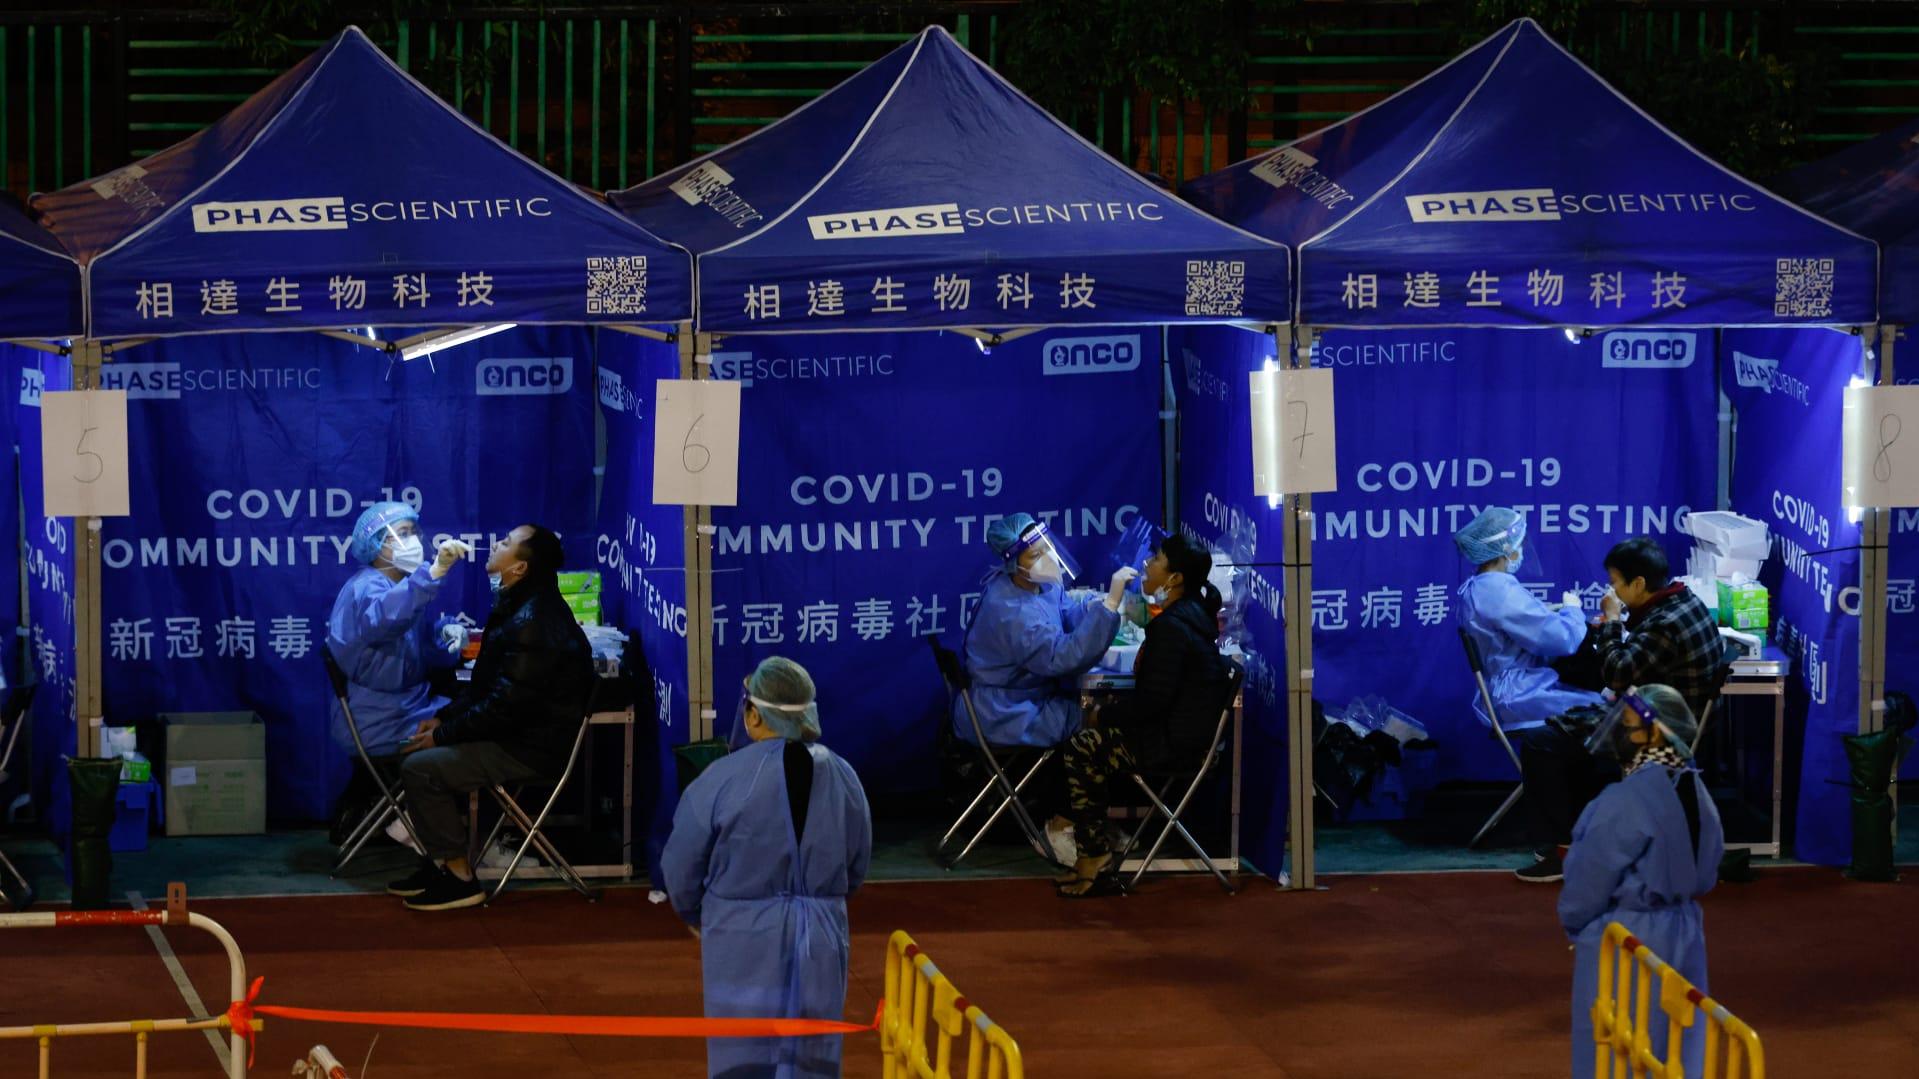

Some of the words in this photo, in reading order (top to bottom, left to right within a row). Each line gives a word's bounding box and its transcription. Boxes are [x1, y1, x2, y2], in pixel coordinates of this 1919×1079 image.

[206, 201, 348, 226] PHASE
[350, 196, 553, 223] SCIENTIFIC
[823, 211, 964, 235] PHASE
[965, 201, 1164, 229] SCIENTIFIC
[1423, 195, 1560, 216] PHASE
[1561, 192, 1757, 215] SCIENTIFIC
[135, 270, 495, 320] 相達生物科技
[743, 271, 1097, 321] 相達生物科技
[1341, 268, 1688, 310] 相達生物科技
[182, 367, 321, 391] SCIENTIFIC
[755, 353, 896, 381] SCIENTIFIC
[682, 412, 711, 474] 6
[1287, 400, 1315, 460] 7
[1873, 413, 1902, 483] 8
[73, 426, 104, 484] 5
[1356, 457, 1562, 493] COVID-19
[790, 466, 1004, 506] COVID-19
[718, 517, 937, 557] MMUNITY
[1772, 489, 1830, 550] COVID-19
[102, 535, 353, 570] OMMUNITY
